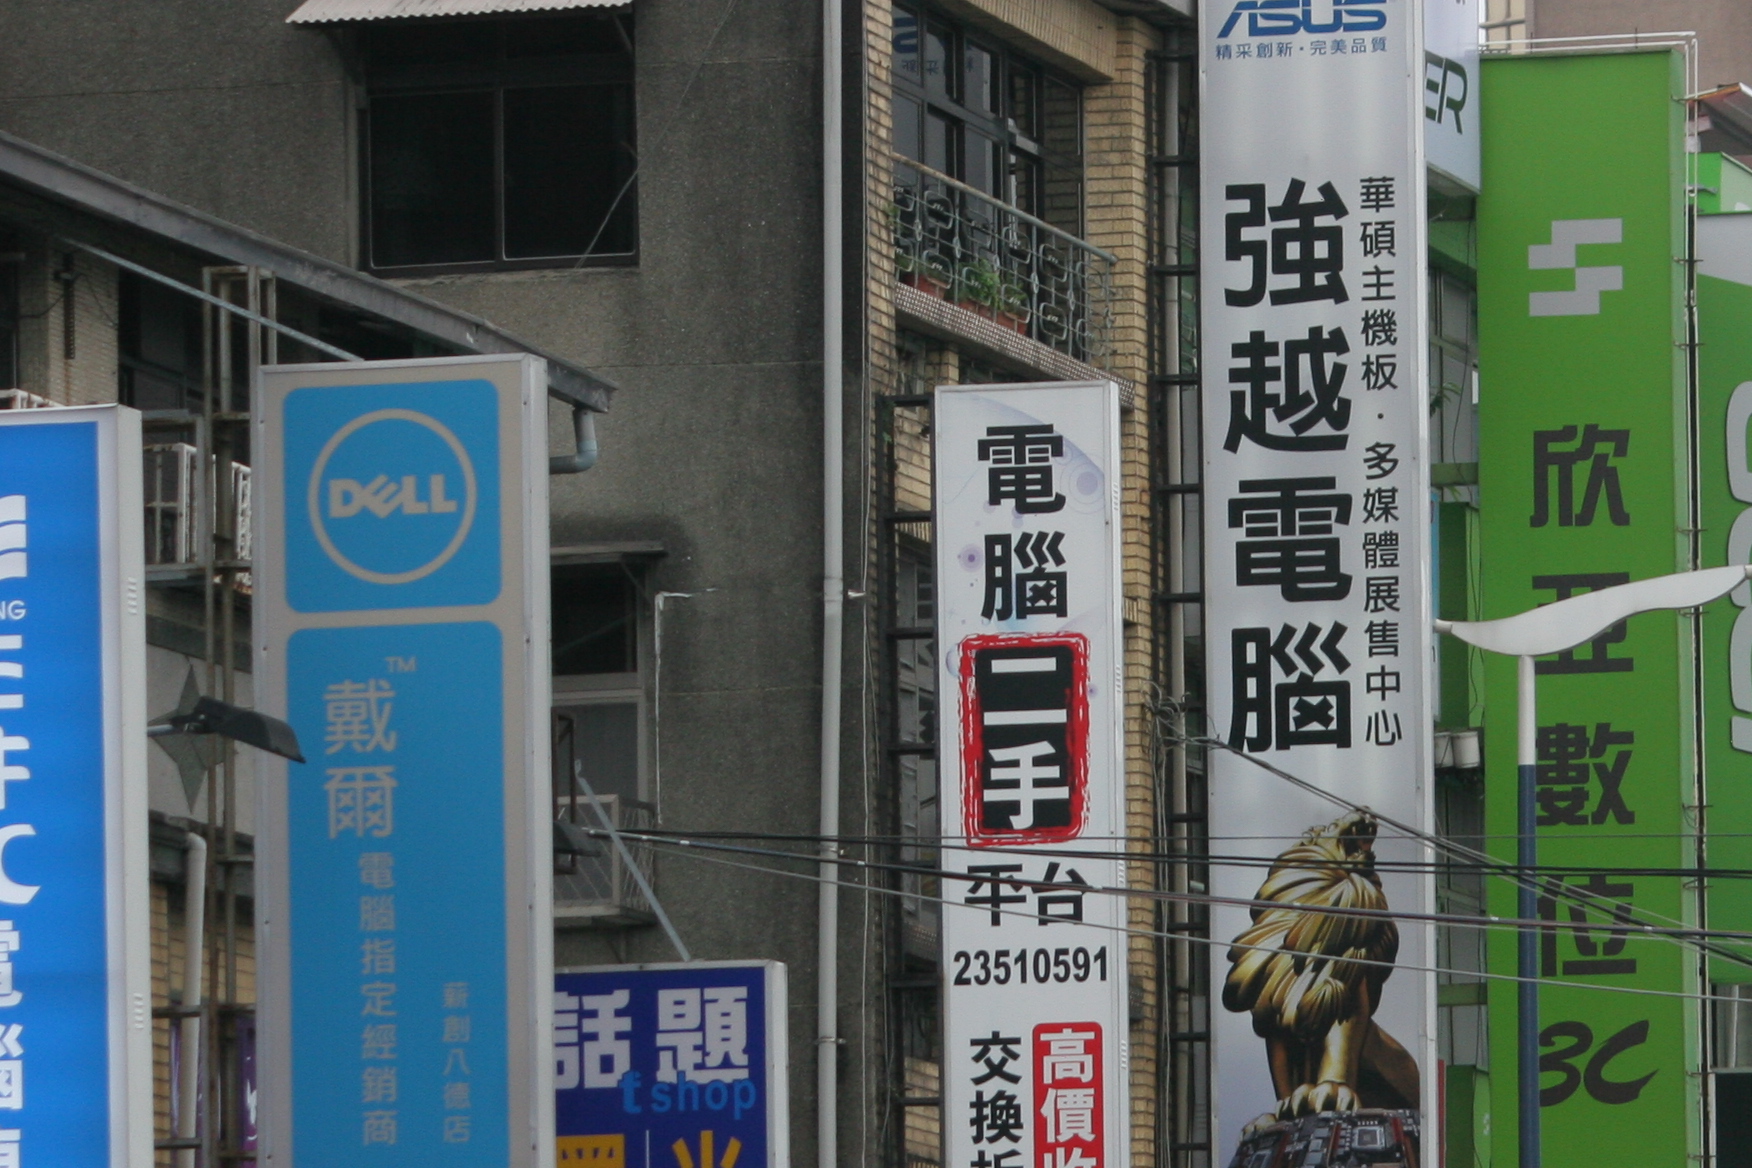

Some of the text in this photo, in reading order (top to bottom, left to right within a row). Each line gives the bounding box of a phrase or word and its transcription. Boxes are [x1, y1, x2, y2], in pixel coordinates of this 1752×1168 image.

[1216, 0, 1387, 39] ASUS
[328, 474, 458, 519] DELL
[1223, 178, 1353, 753] 強越電腦
[977, 423, 1068, 622] 電腦
[323, 678, 398, 840] 戴爾
[983, 656, 1070, 831] 二手
[964, 861, 1087, 927] 平台
[358, 851, 399, 1147] 電腦指定經銷商
[953, 945, 1110, 987] 23510591
[553, 985, 749, 1090] 話題
[651, 1071, 757, 1121] shop
